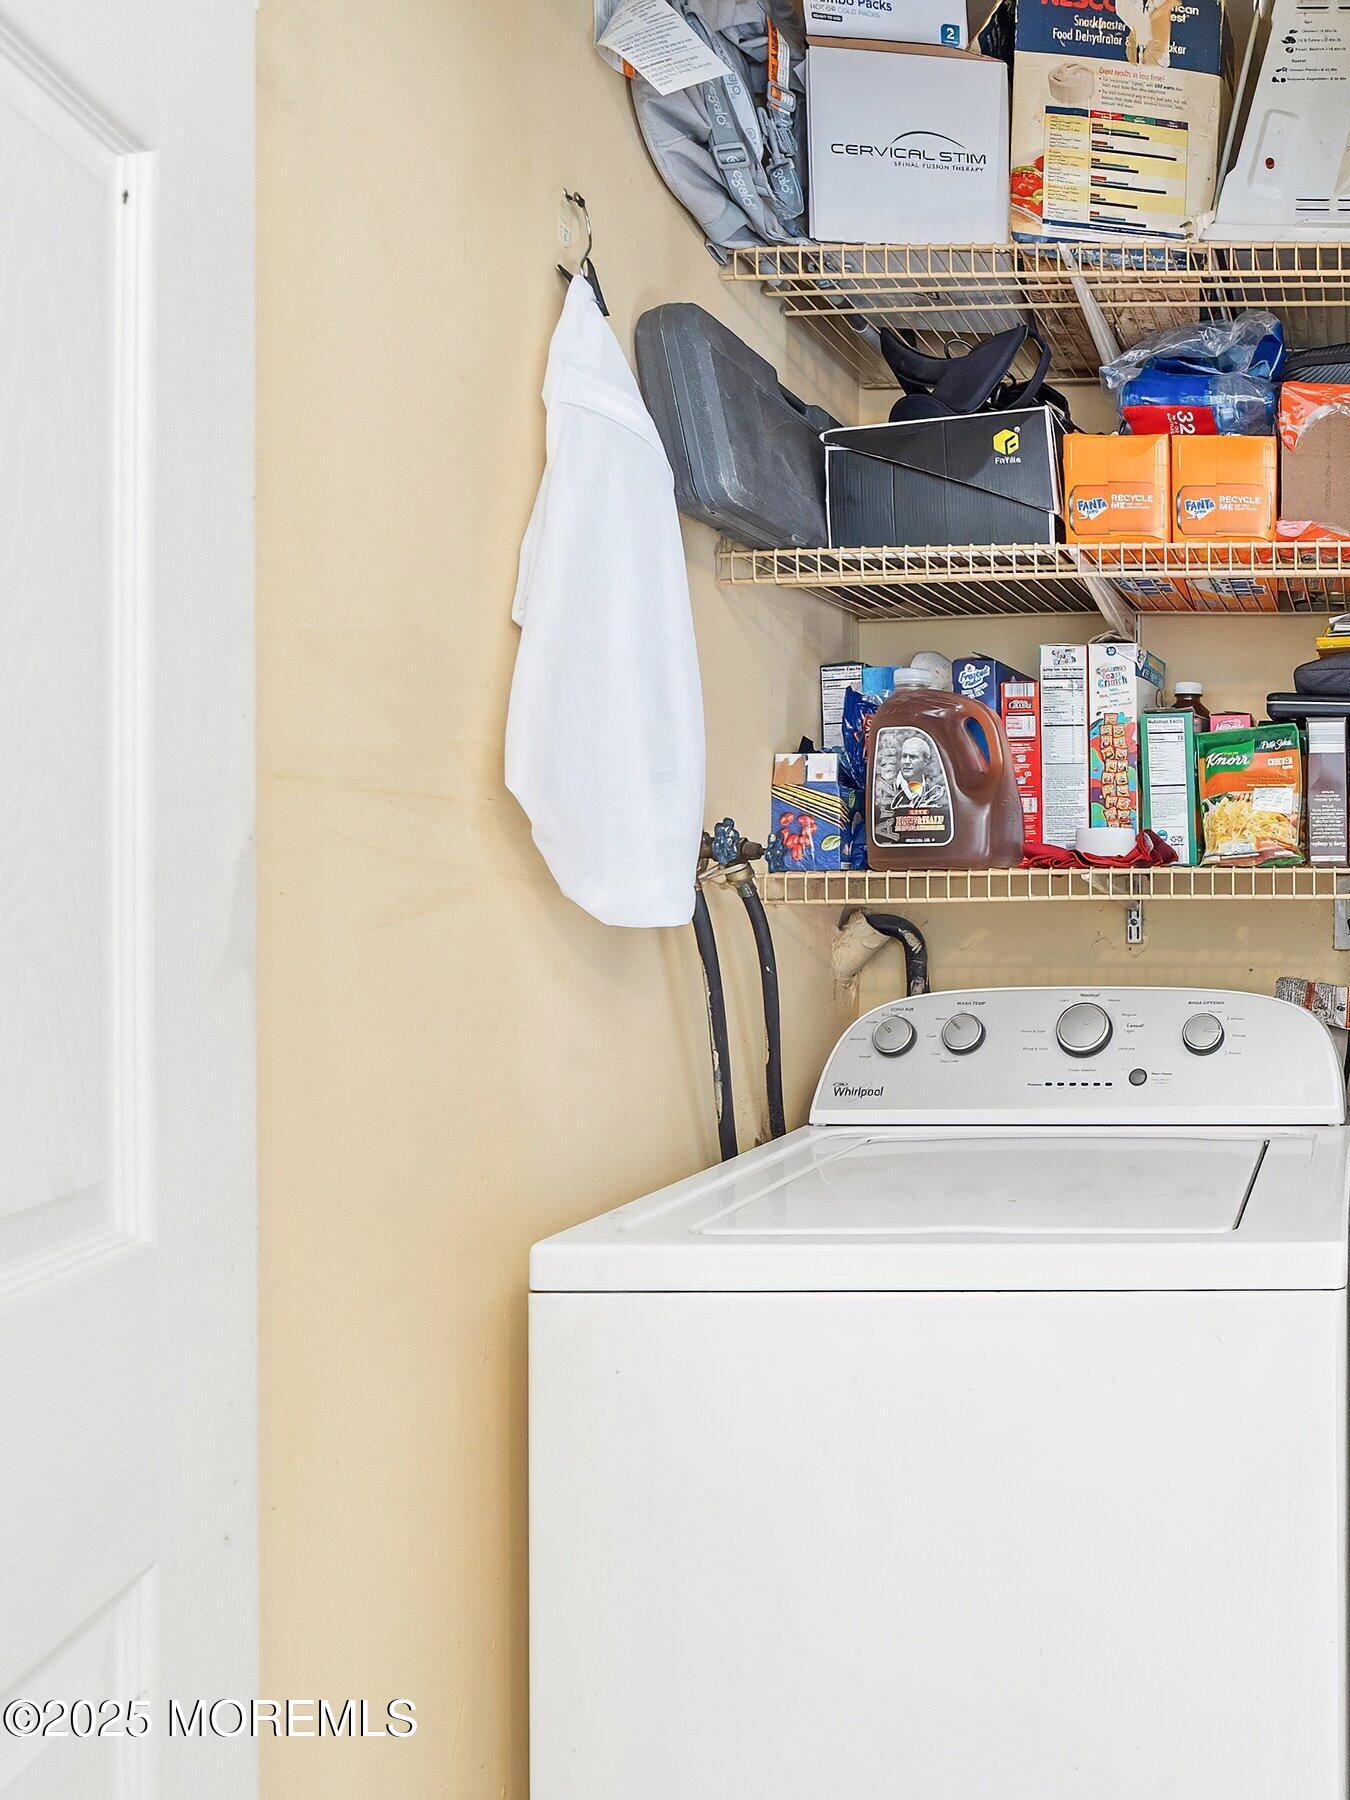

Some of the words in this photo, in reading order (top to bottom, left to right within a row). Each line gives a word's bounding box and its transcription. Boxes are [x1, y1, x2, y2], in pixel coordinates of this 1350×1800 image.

[946, 27, 955, 39] 2
[1052, 28, 1073, 42] Food
[1075, 29, 1123, 46] Dehydrator
[831, 143, 936, 161] CERVICAL
[939, 151, 987, 165] STIM
[894, 161, 919, 169] SPINAL
[922, 163, 949, 171] FUSION
[952, 165, 984, 173] THERAPY
[1111, 494, 1153, 502] RECYCLE
[1077, 499, 1107, 510] FANTA
[1185, 500, 1215, 510] FANTA
[1206, 753, 1250, 769] Knorr
[832, 1086, 883, 1098] Whirlpool
